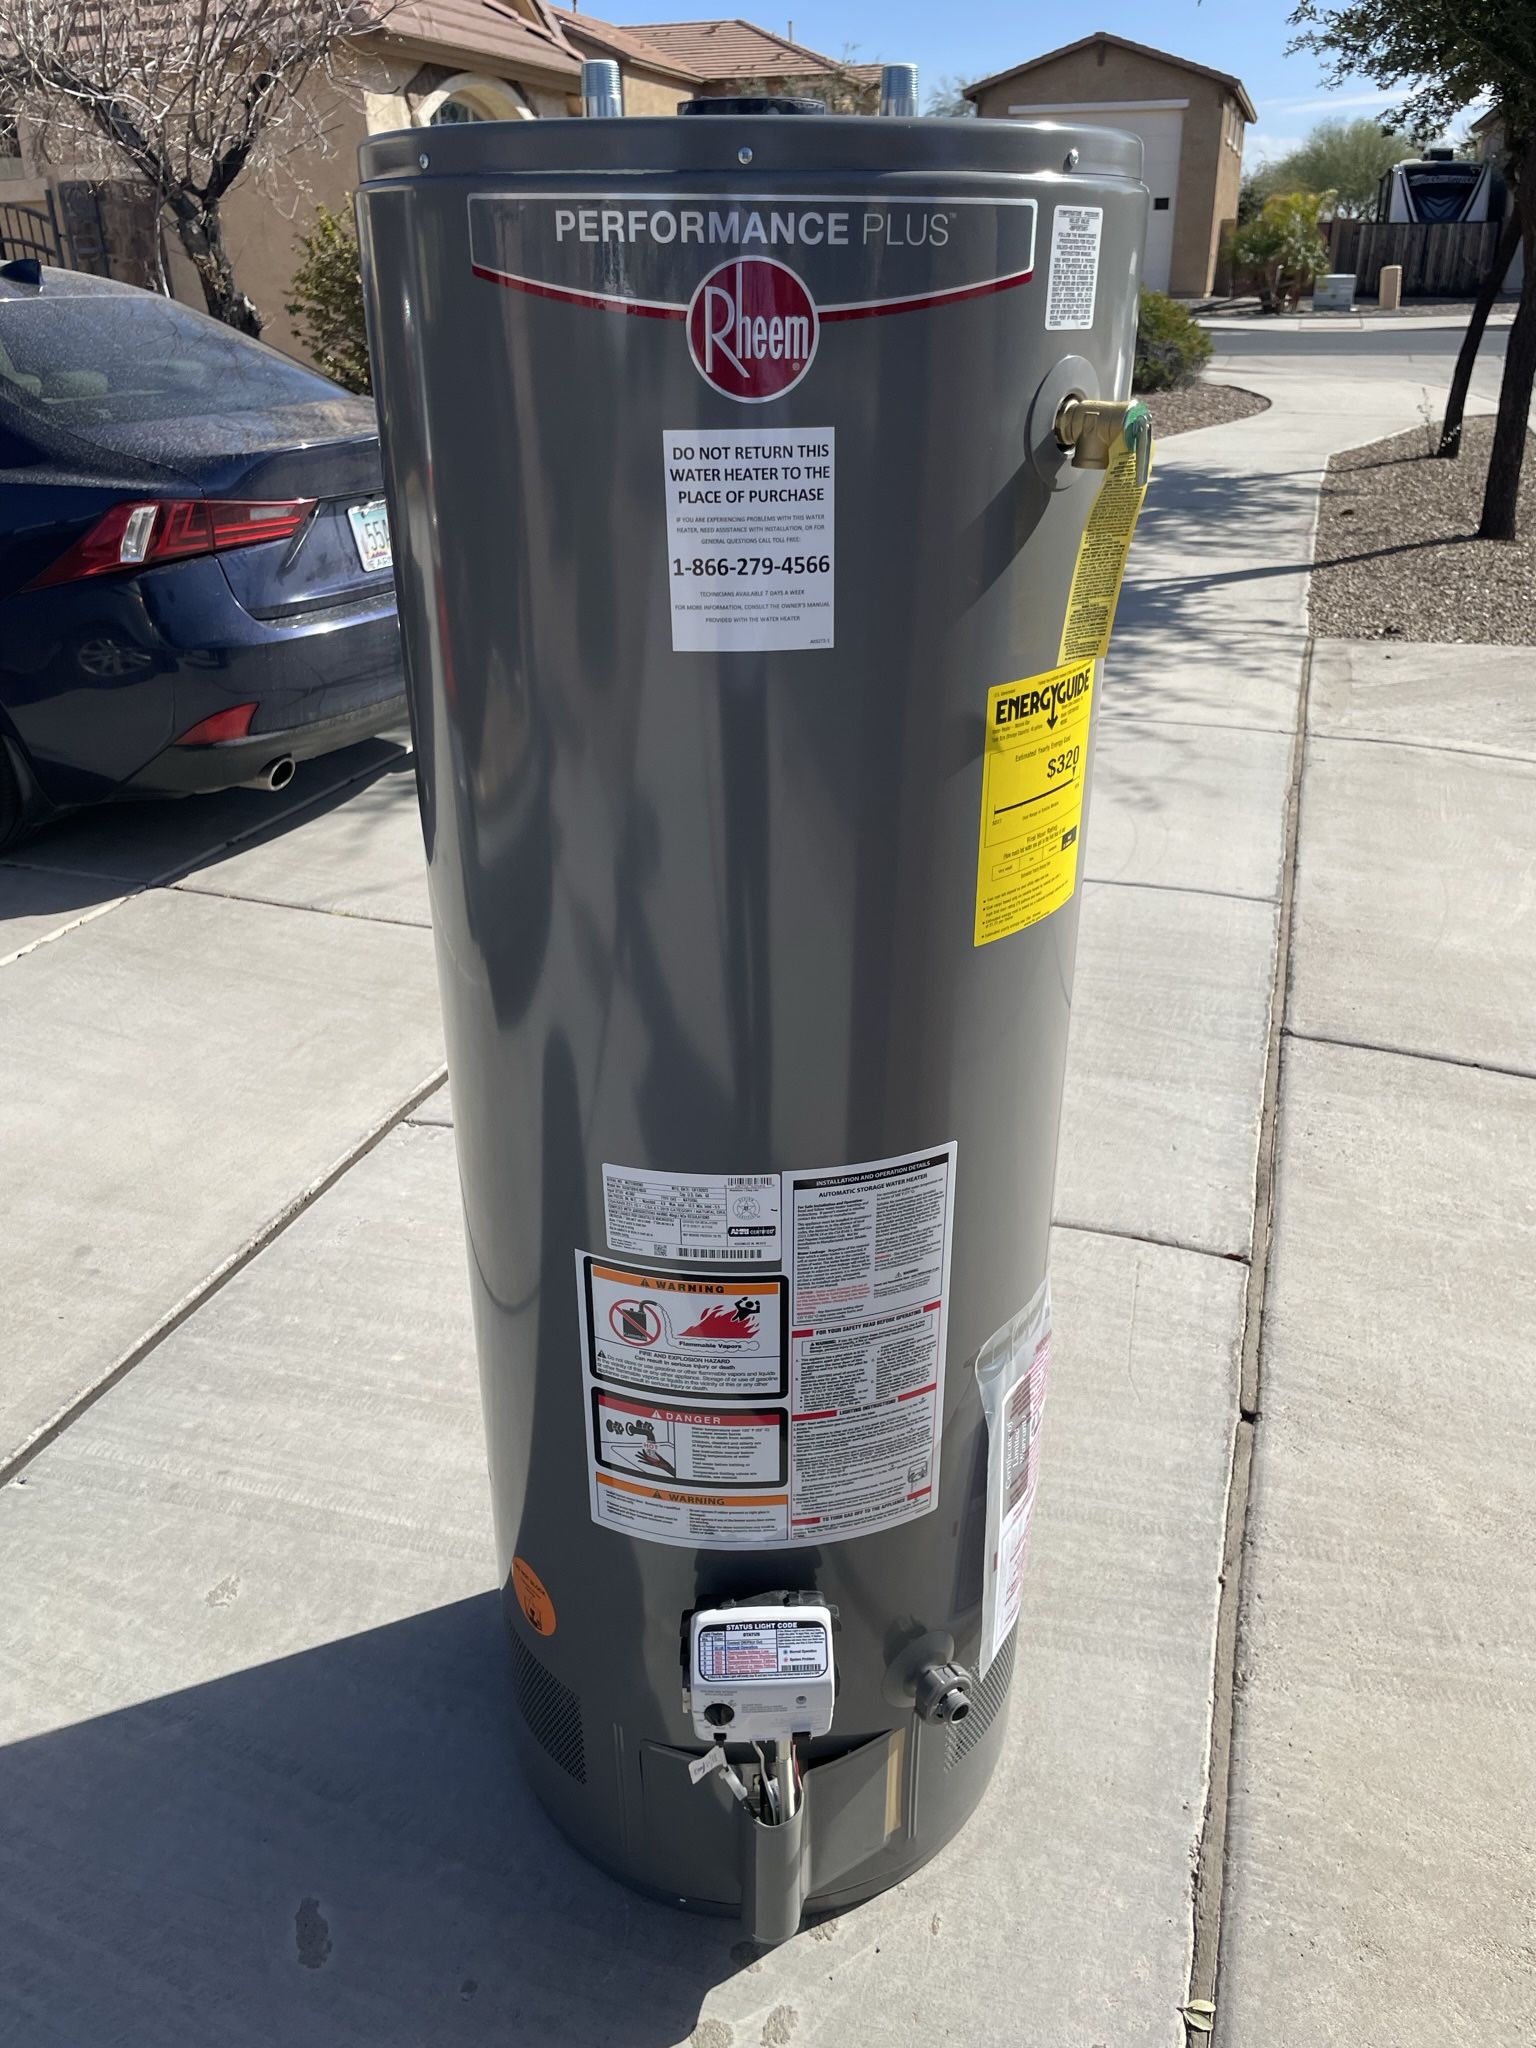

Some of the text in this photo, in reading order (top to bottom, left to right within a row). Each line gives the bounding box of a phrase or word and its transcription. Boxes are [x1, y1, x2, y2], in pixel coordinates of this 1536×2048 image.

[555, 210, 949, 246] PERFORMANCE PLUS
[705, 262, 808, 378] Rheem
[673, 444, 829, 460] DO NOT RETURN THIS
[670, 466, 830, 481] WATER HEATER TO THE
[679, 488, 824, 503] PLACE OF PURCHASE
[674, 555, 830, 576] 1-866-279-4566
[996, 668, 1090, 726] ENERGYGUIDE
[1047, 745, 1079, 780] $320
[816, 1176, 859, 1186] INSTALLATION
[875, 1167, 908, 1178] OPERATION
[908, 1161, 930, 1170] DETAILS
[819, 1173, 927, 1197] AUTOMATIC STORAGE WATER HEATER
[656, 1281, 724, 1294] WARNING
[666, 1412, 721, 1424] DANGER
[669, 1494, 724, 1505] WARNING
